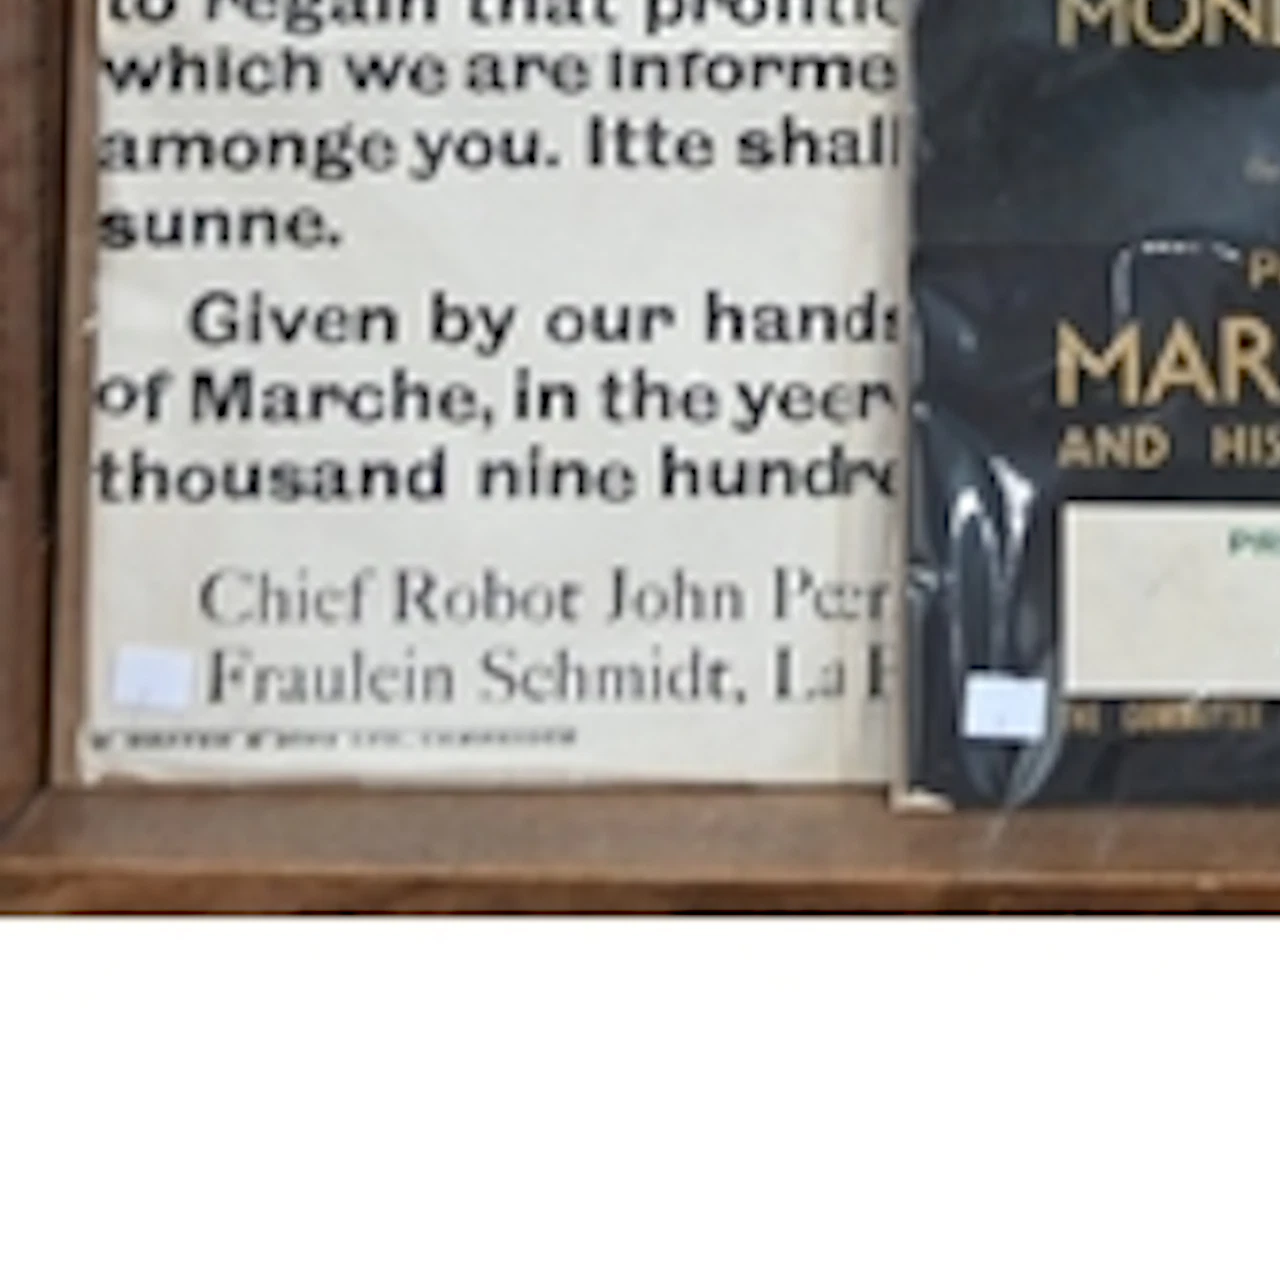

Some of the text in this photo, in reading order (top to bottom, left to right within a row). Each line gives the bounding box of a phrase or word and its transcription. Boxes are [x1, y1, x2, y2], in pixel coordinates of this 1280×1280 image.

[104, 44, 321, 95] which
[344, 53, 448, 95] we
[465, 53, 591, 95] are
[99, 120, 399, 181] amonge
[411, 129, 562, 181] you.
[588, 113, 715, 171] Itte
[98, 206, 344, 251] sunne.
[187, 289, 399, 348] Given
[428, 289, 515, 358] by
[545, 300, 676, 346] our
[92, 369, 174, 423] of
[191, 369, 497, 432] Marche,
[515, 369, 578, 421] in
[600, 367, 721, 421] the
[92, 448, 448, 504] thousand
[477, 444, 638, 503] nine
[1056, 423, 1171, 470] AND
[198, 566, 372, 627] Chief
[393, 566, 583, 625] Robot
[604, 566, 745, 625] John
[479, 644, 748, 709] Schmidt,
